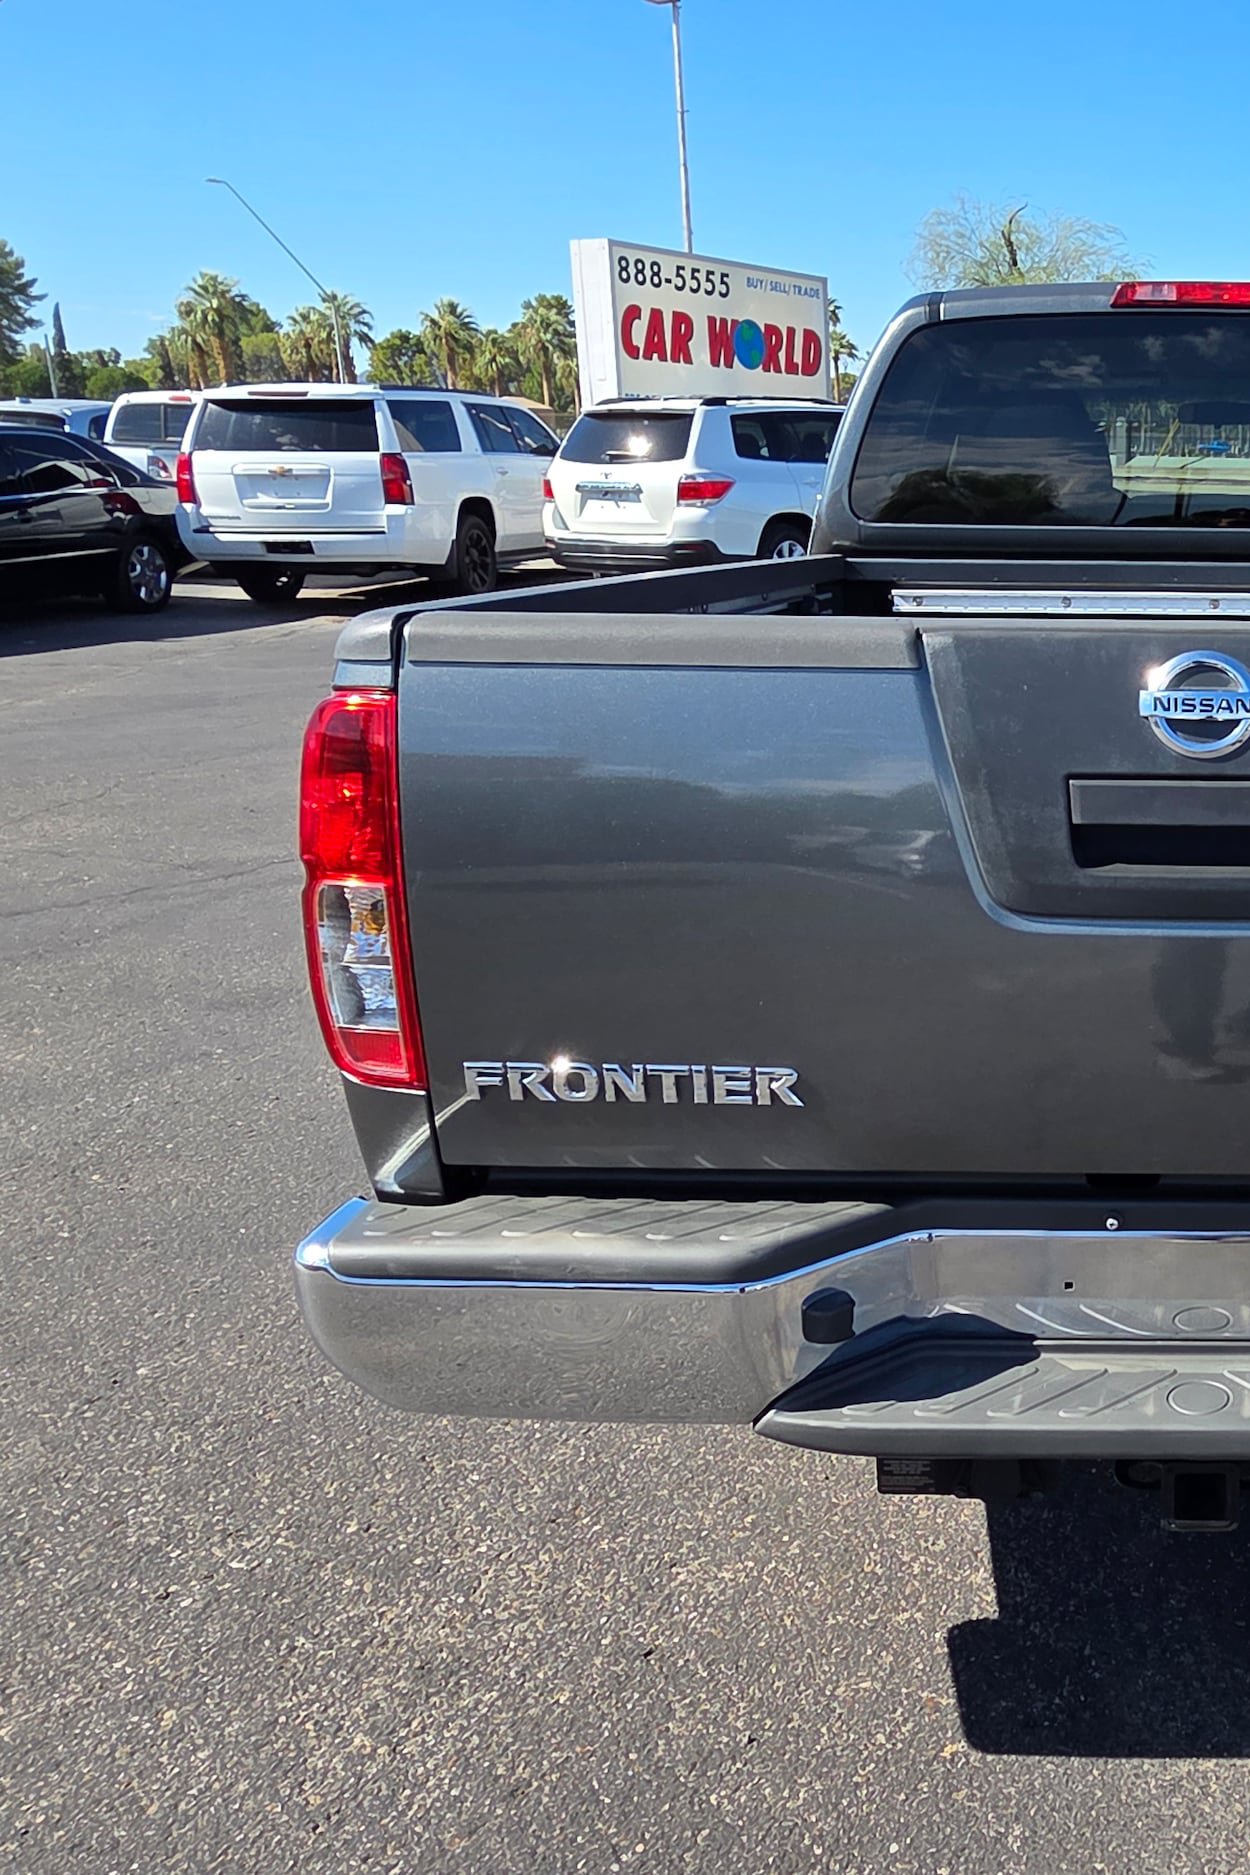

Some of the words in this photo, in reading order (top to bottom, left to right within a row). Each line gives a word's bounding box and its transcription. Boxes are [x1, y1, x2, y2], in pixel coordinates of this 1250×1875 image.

[618, 255, 730, 298] 888-5555
[620, 303, 693, 365] CAR
[706, 315, 823, 377] WORLD
[463, 1060, 805, 1107] FRONTIER
